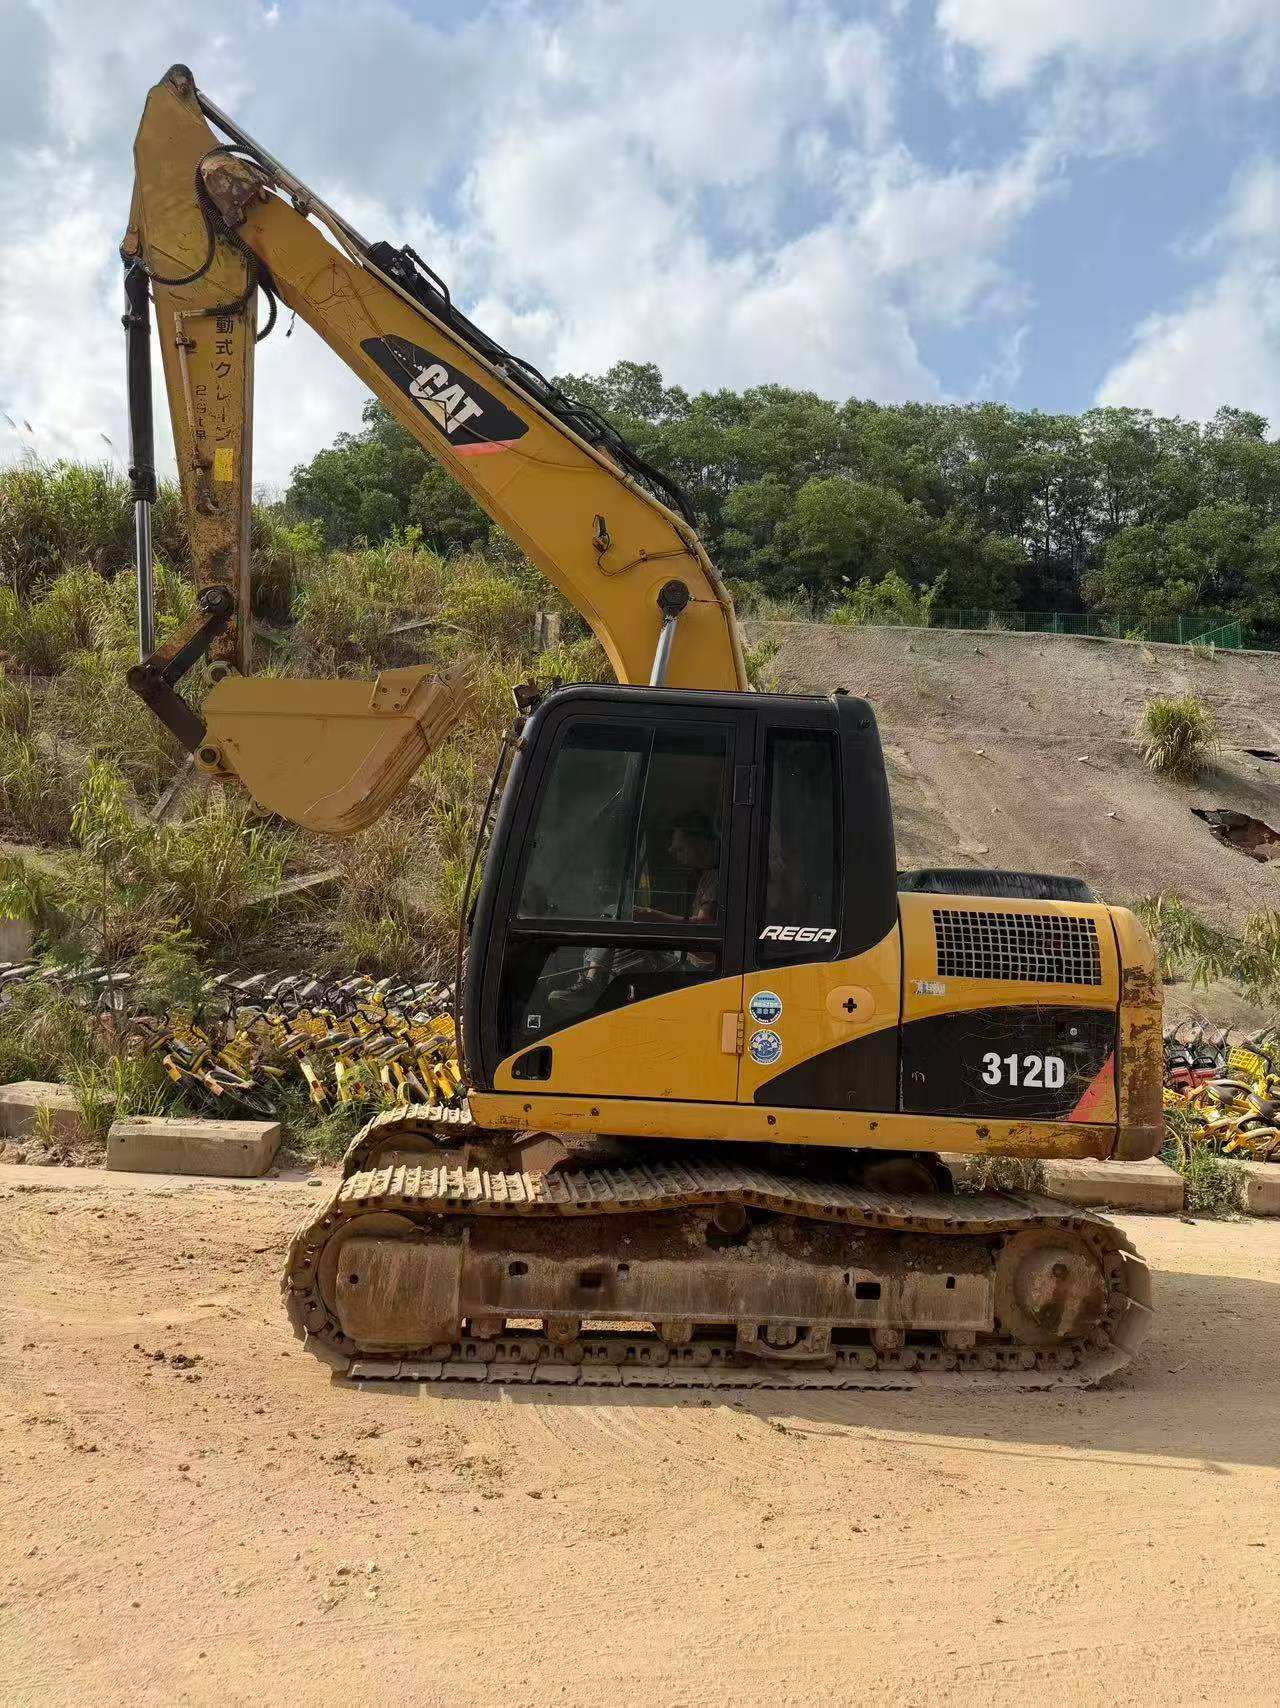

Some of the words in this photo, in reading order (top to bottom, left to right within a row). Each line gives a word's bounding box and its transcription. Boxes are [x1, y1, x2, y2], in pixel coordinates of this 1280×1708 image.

[215, 297, 234, 442] 動式クレーン
[409, 363, 484, 434] CAT
[758, 925, 837, 943] REGA
[982, 1052, 1065, 1089] 312D
